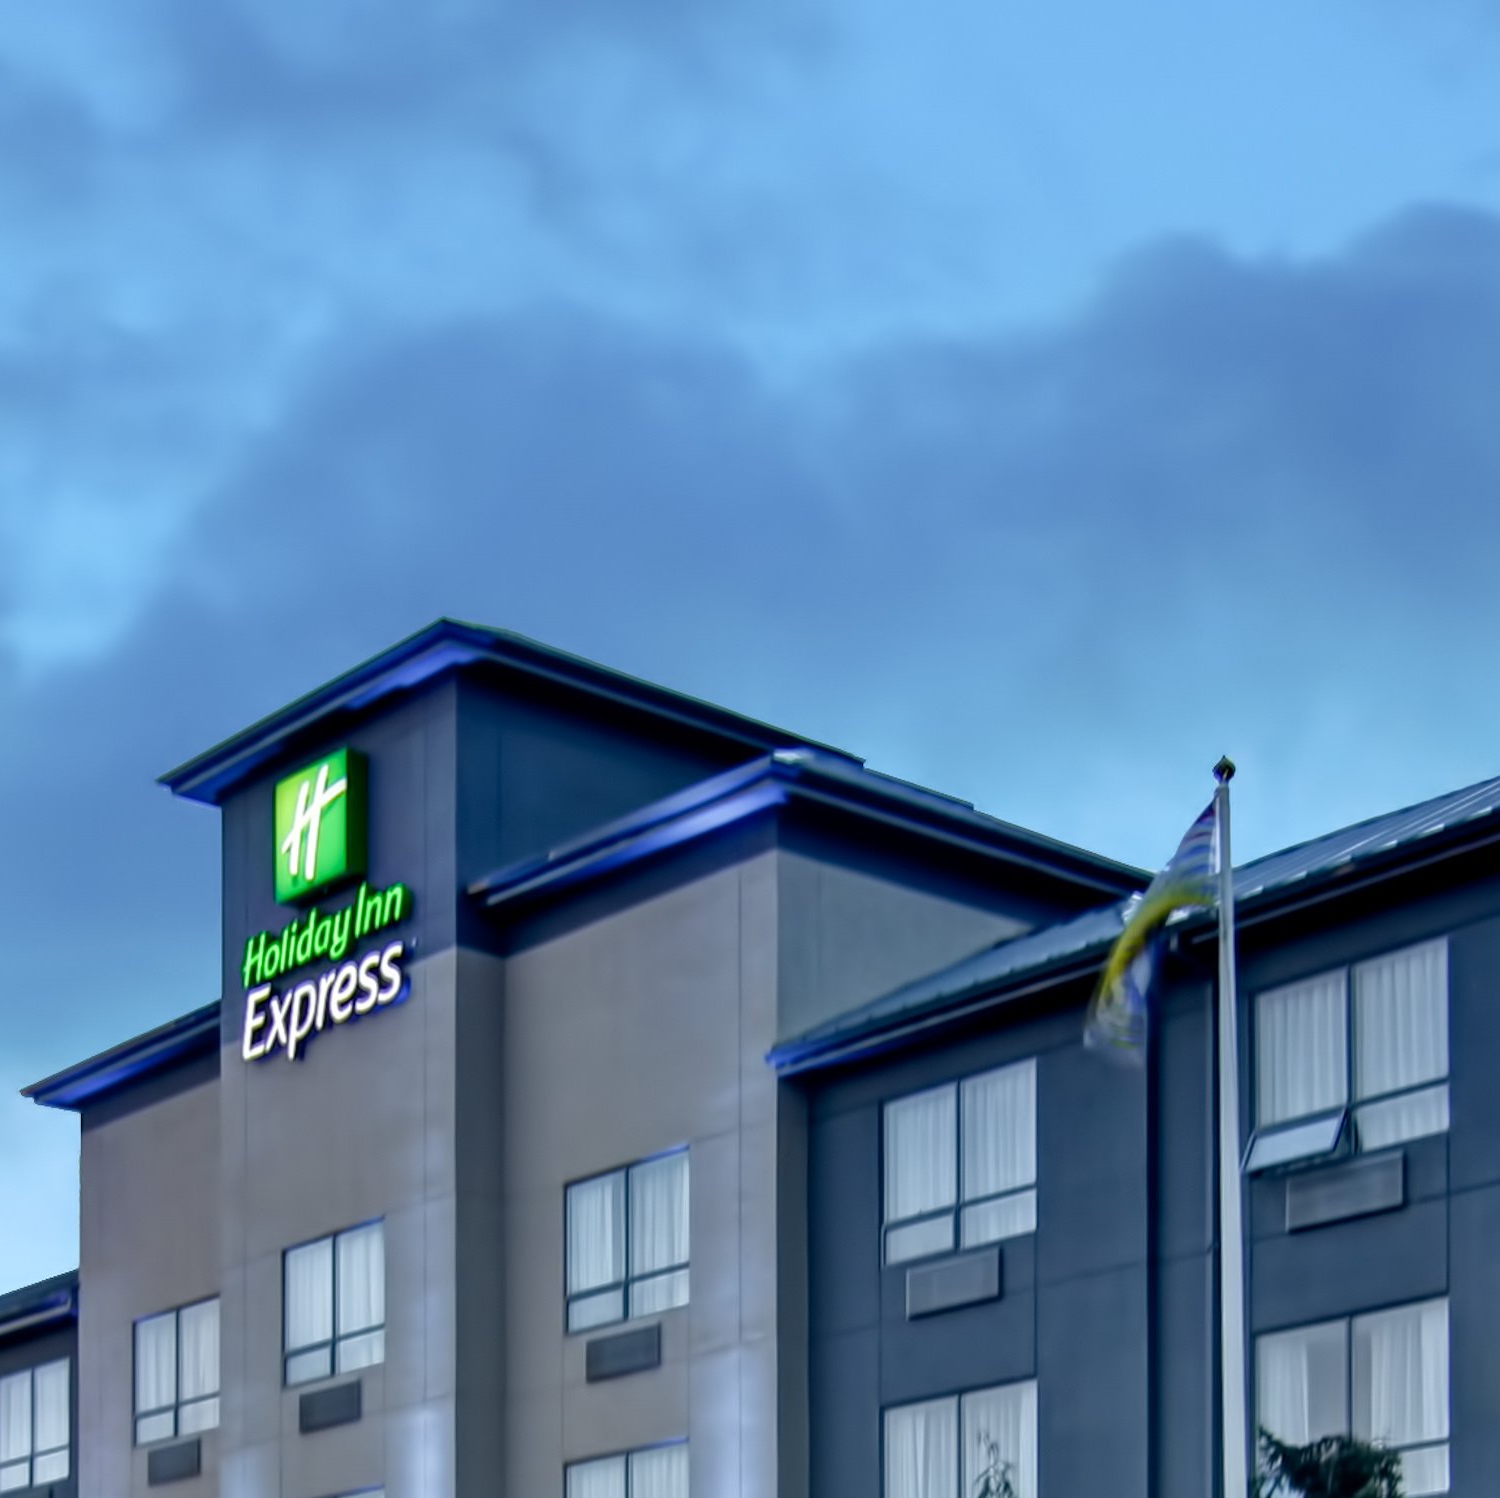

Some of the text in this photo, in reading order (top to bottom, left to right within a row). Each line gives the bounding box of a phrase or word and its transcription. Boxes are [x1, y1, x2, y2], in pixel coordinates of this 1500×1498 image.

[242, 881, 404, 988] Holiday Inn
[241, 940, 404, 1061] Express
